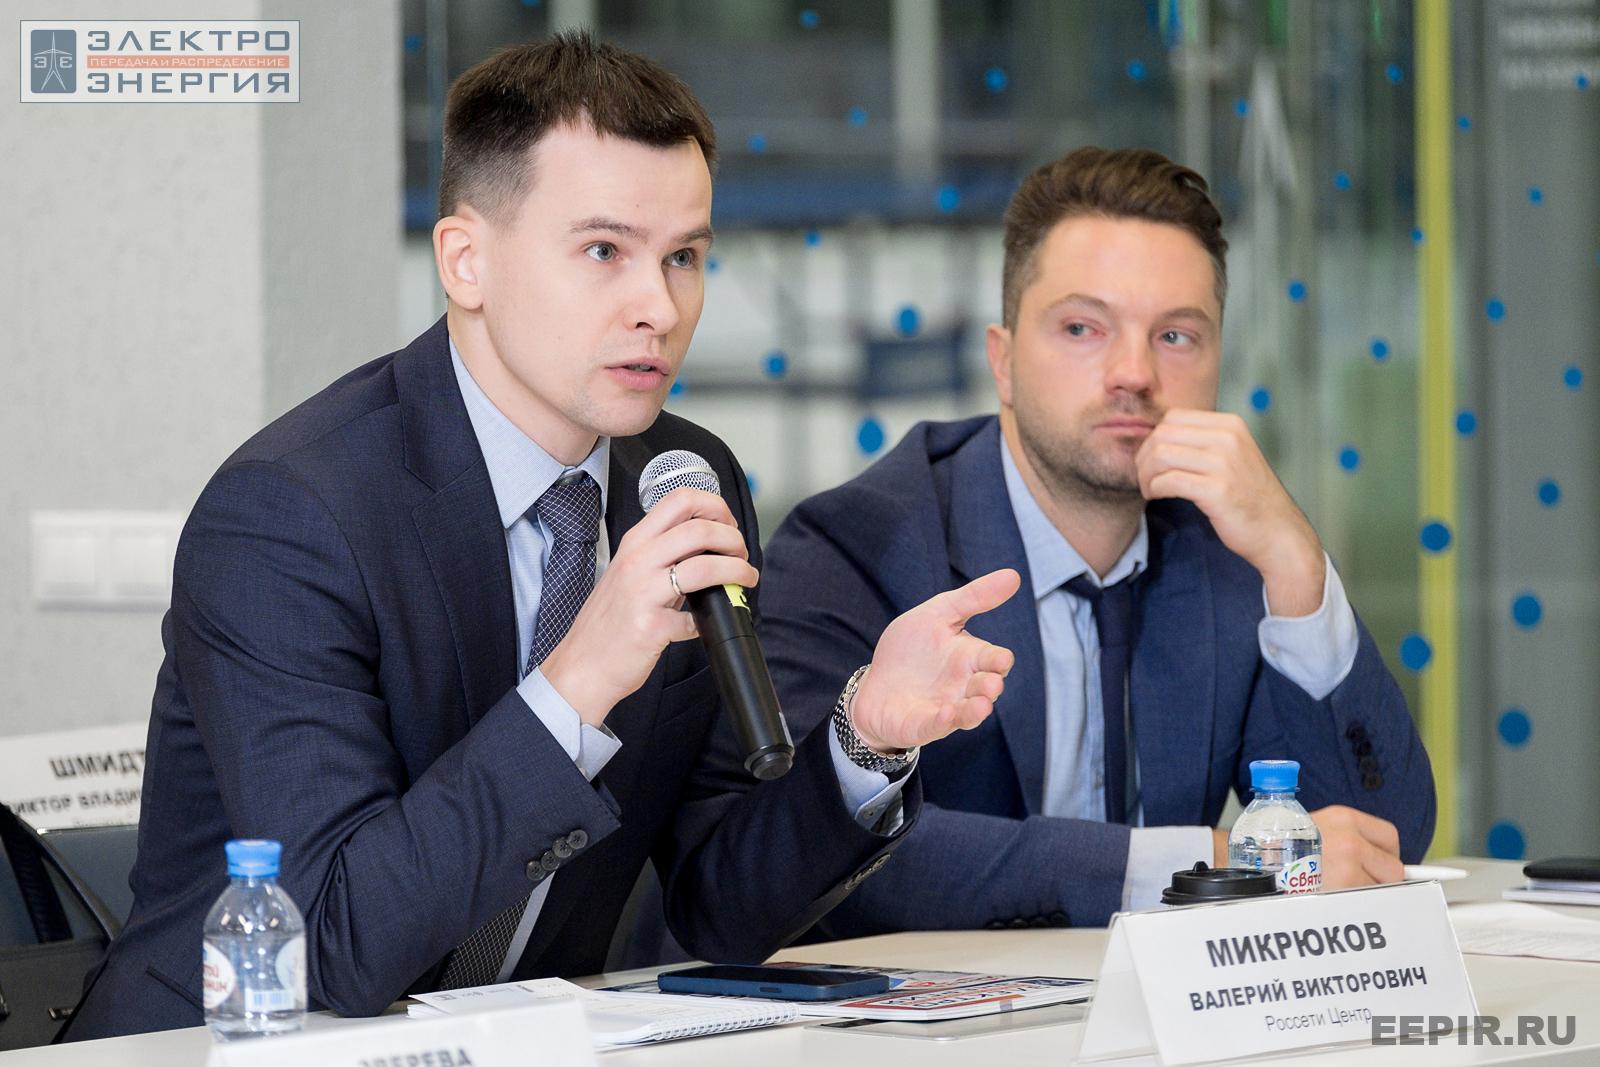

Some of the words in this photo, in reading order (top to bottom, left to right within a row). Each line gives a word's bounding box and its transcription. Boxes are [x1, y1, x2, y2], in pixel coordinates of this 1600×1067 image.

[13, 794, 71, 814] ИКТОР
[1205, 921, 1387, 967] МИКРЮКОВ
[1188, 977, 1288, 1011] ВАЛЕРИЙ
[1292, 966, 1428, 1000] ВИКТОРОВИЧ
[1265, 1011, 1326, 1031] Россети
[1328, 1006, 1373, 1028] Центр
